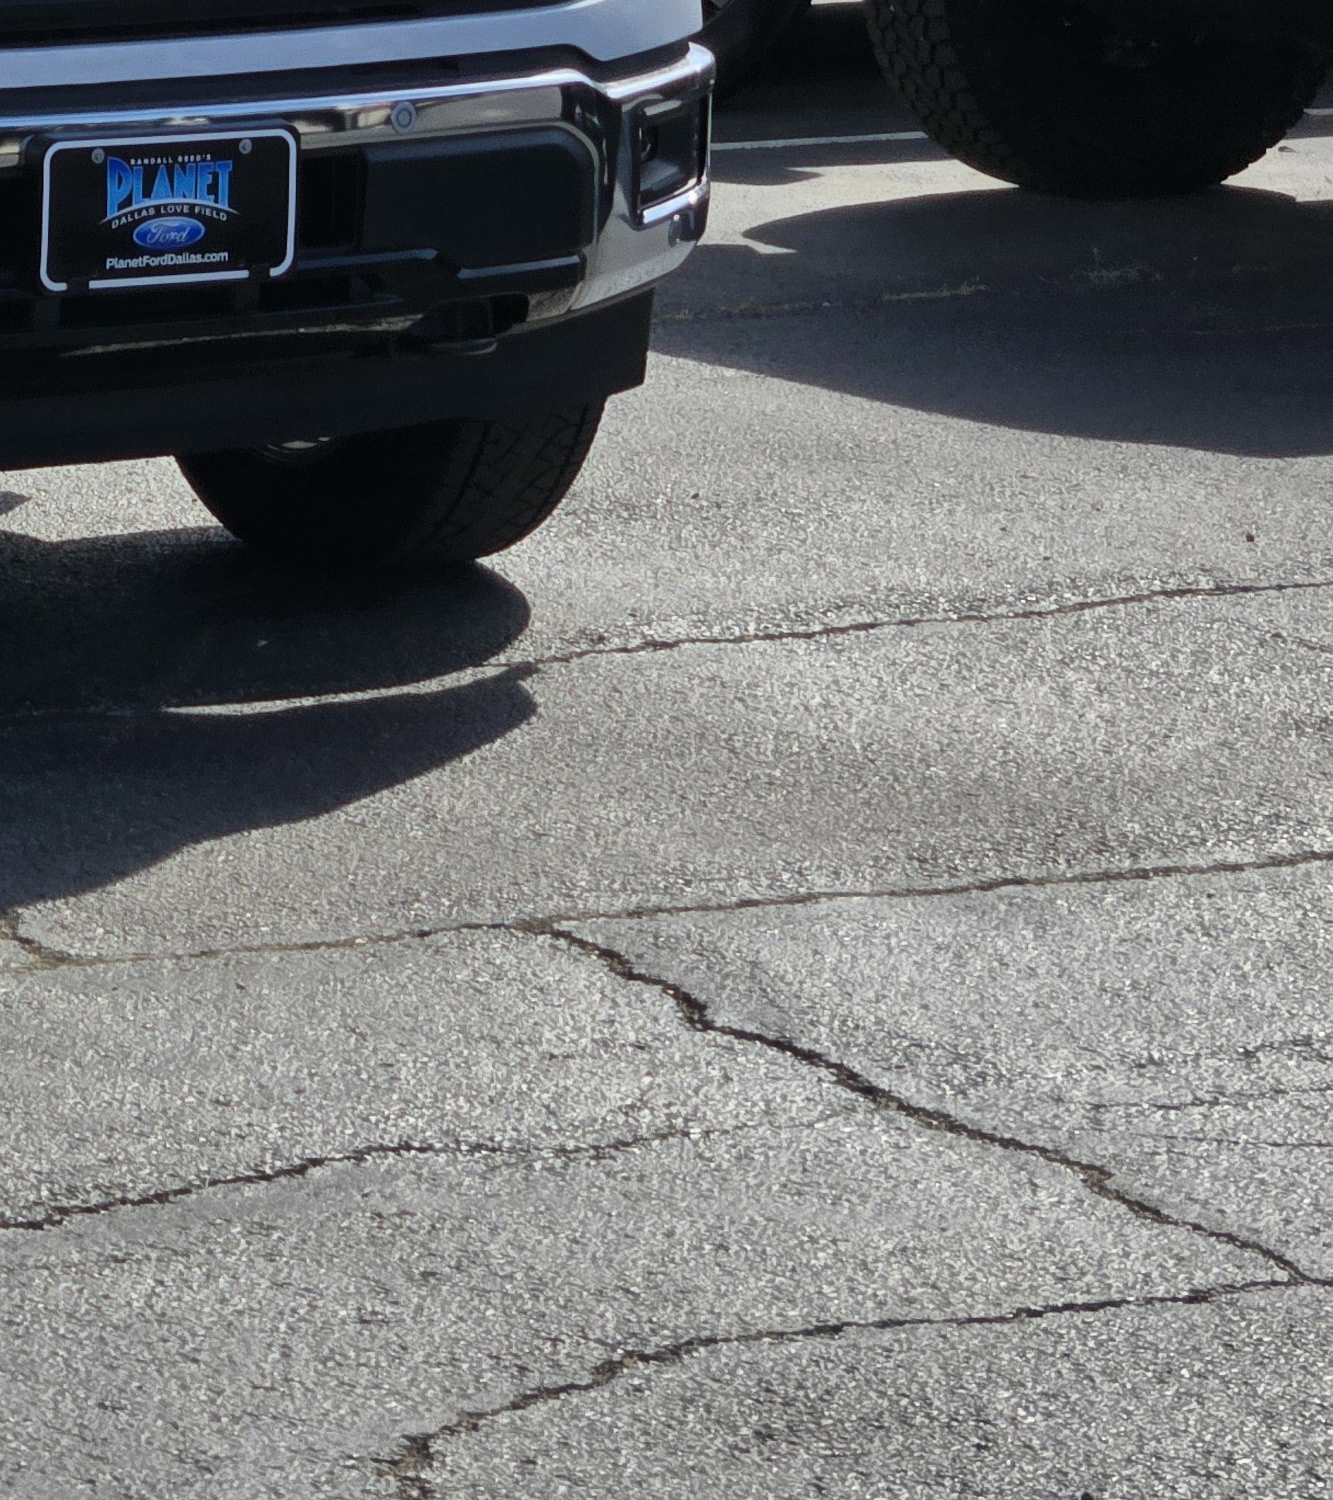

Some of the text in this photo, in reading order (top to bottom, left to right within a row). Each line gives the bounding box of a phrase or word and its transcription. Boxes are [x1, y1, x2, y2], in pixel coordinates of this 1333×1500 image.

[107, 156, 233, 219] PLANET
[111, 204, 228, 229] DALLAS LOVE FIELD
[105, 251, 229, 270] PlanetFordDallas.com
